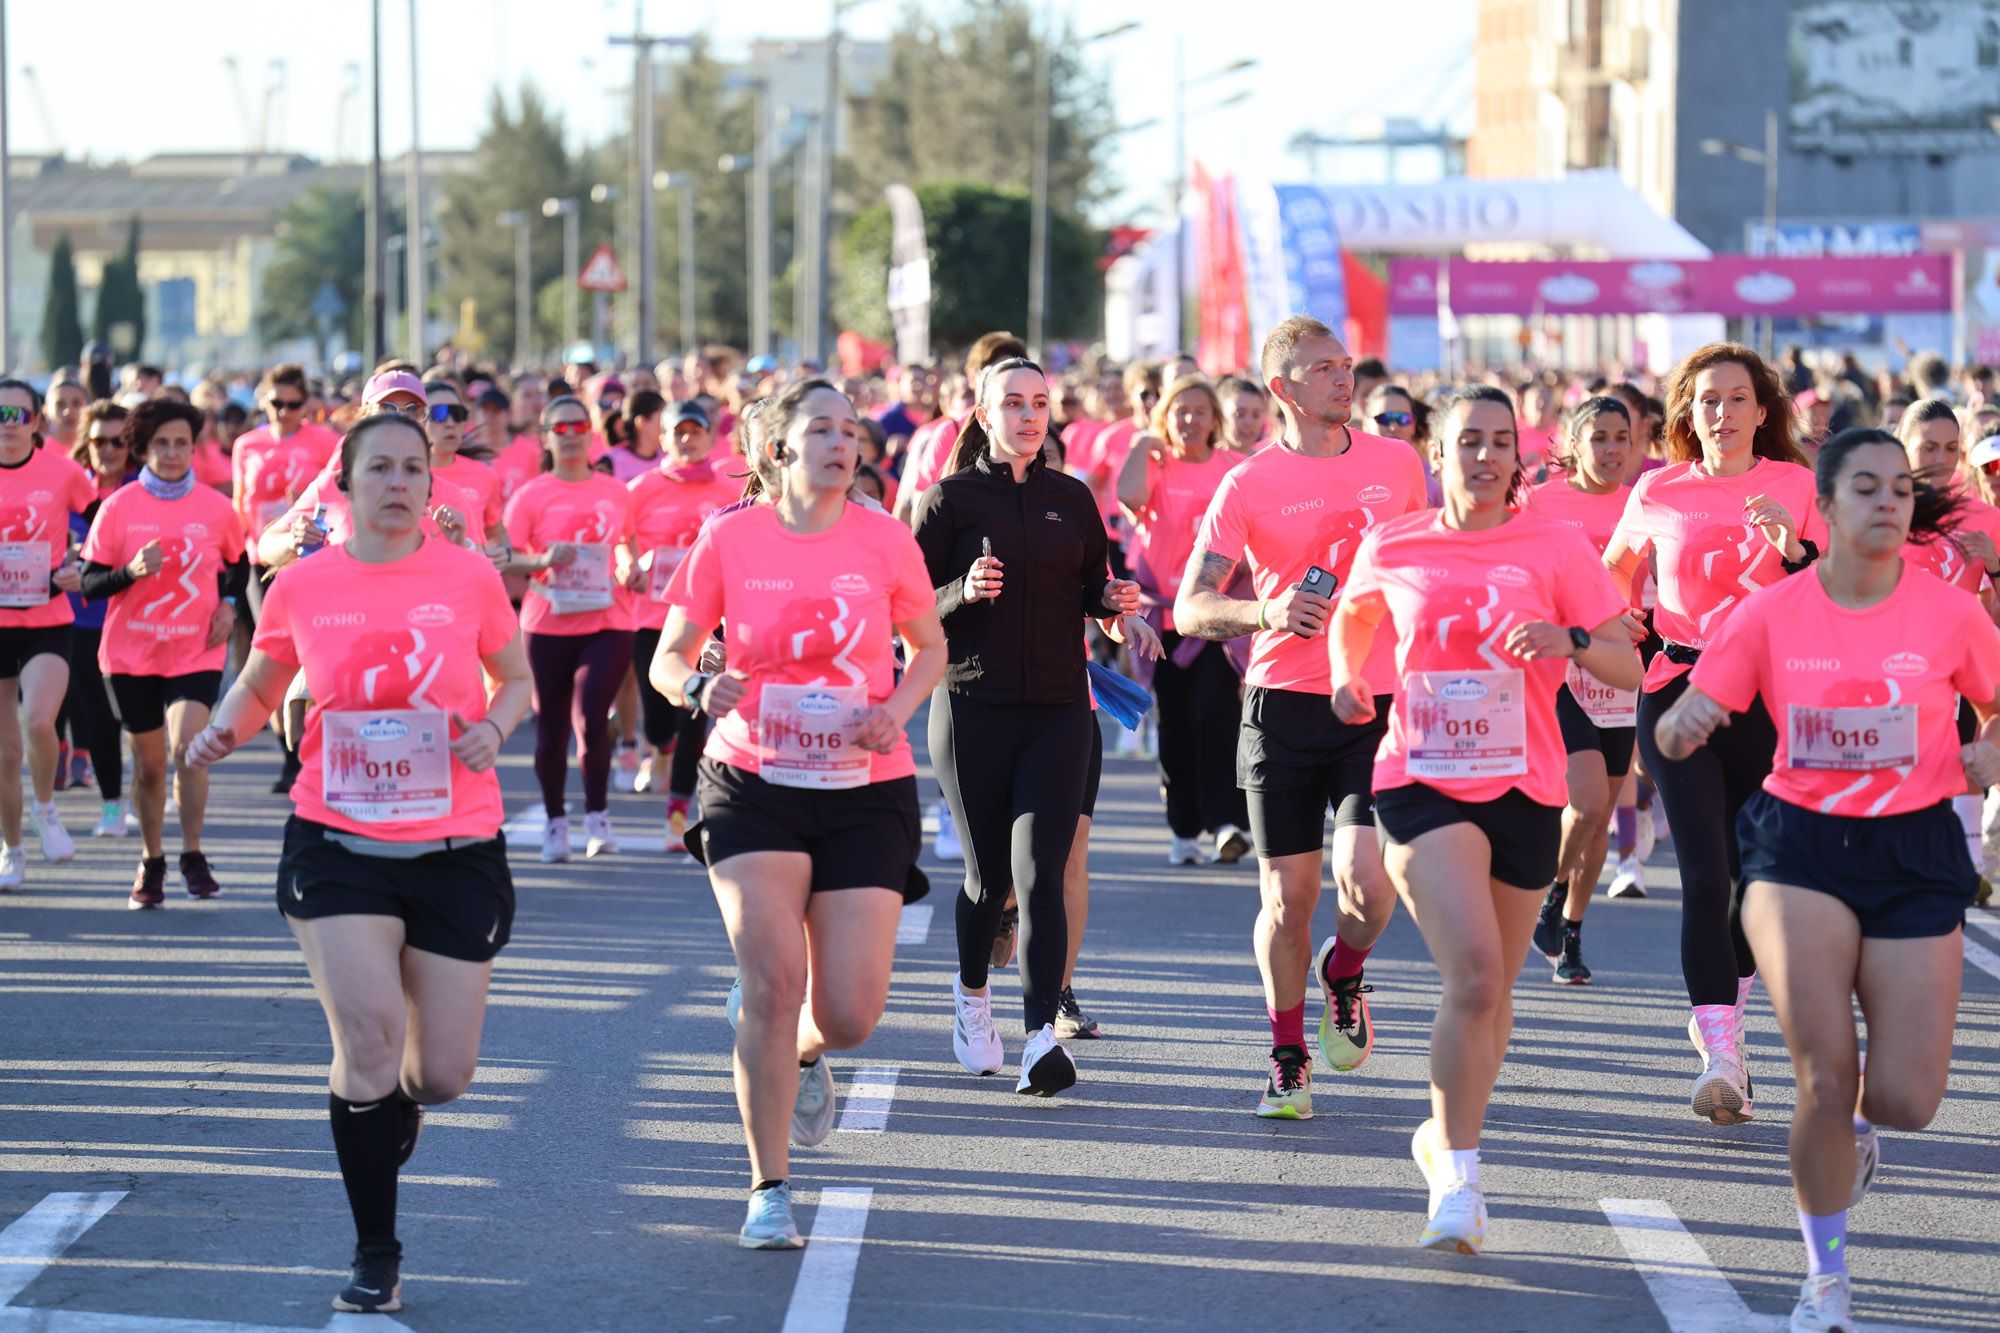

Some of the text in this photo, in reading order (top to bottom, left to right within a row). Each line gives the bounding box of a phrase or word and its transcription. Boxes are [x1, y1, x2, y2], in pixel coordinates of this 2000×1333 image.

[1333, 193, 1519, 234] OYSHO
[1281, 498, 1325, 516] OYSHO
[2, 570, 30, 581] 016
[744, 578, 794, 591] OYSHO
[312, 611, 367, 628] OYSHO
[1785, 656, 1841, 672] OYSHO
[1588, 687, 1615, 700] 016
[1446, 718, 1490, 737] 016
[799, 732, 842, 749] 016
[1831, 728, 1880, 748] 016
[365, 759, 412, 779] 016
[1420, 762, 1457, 773] OYSHO
